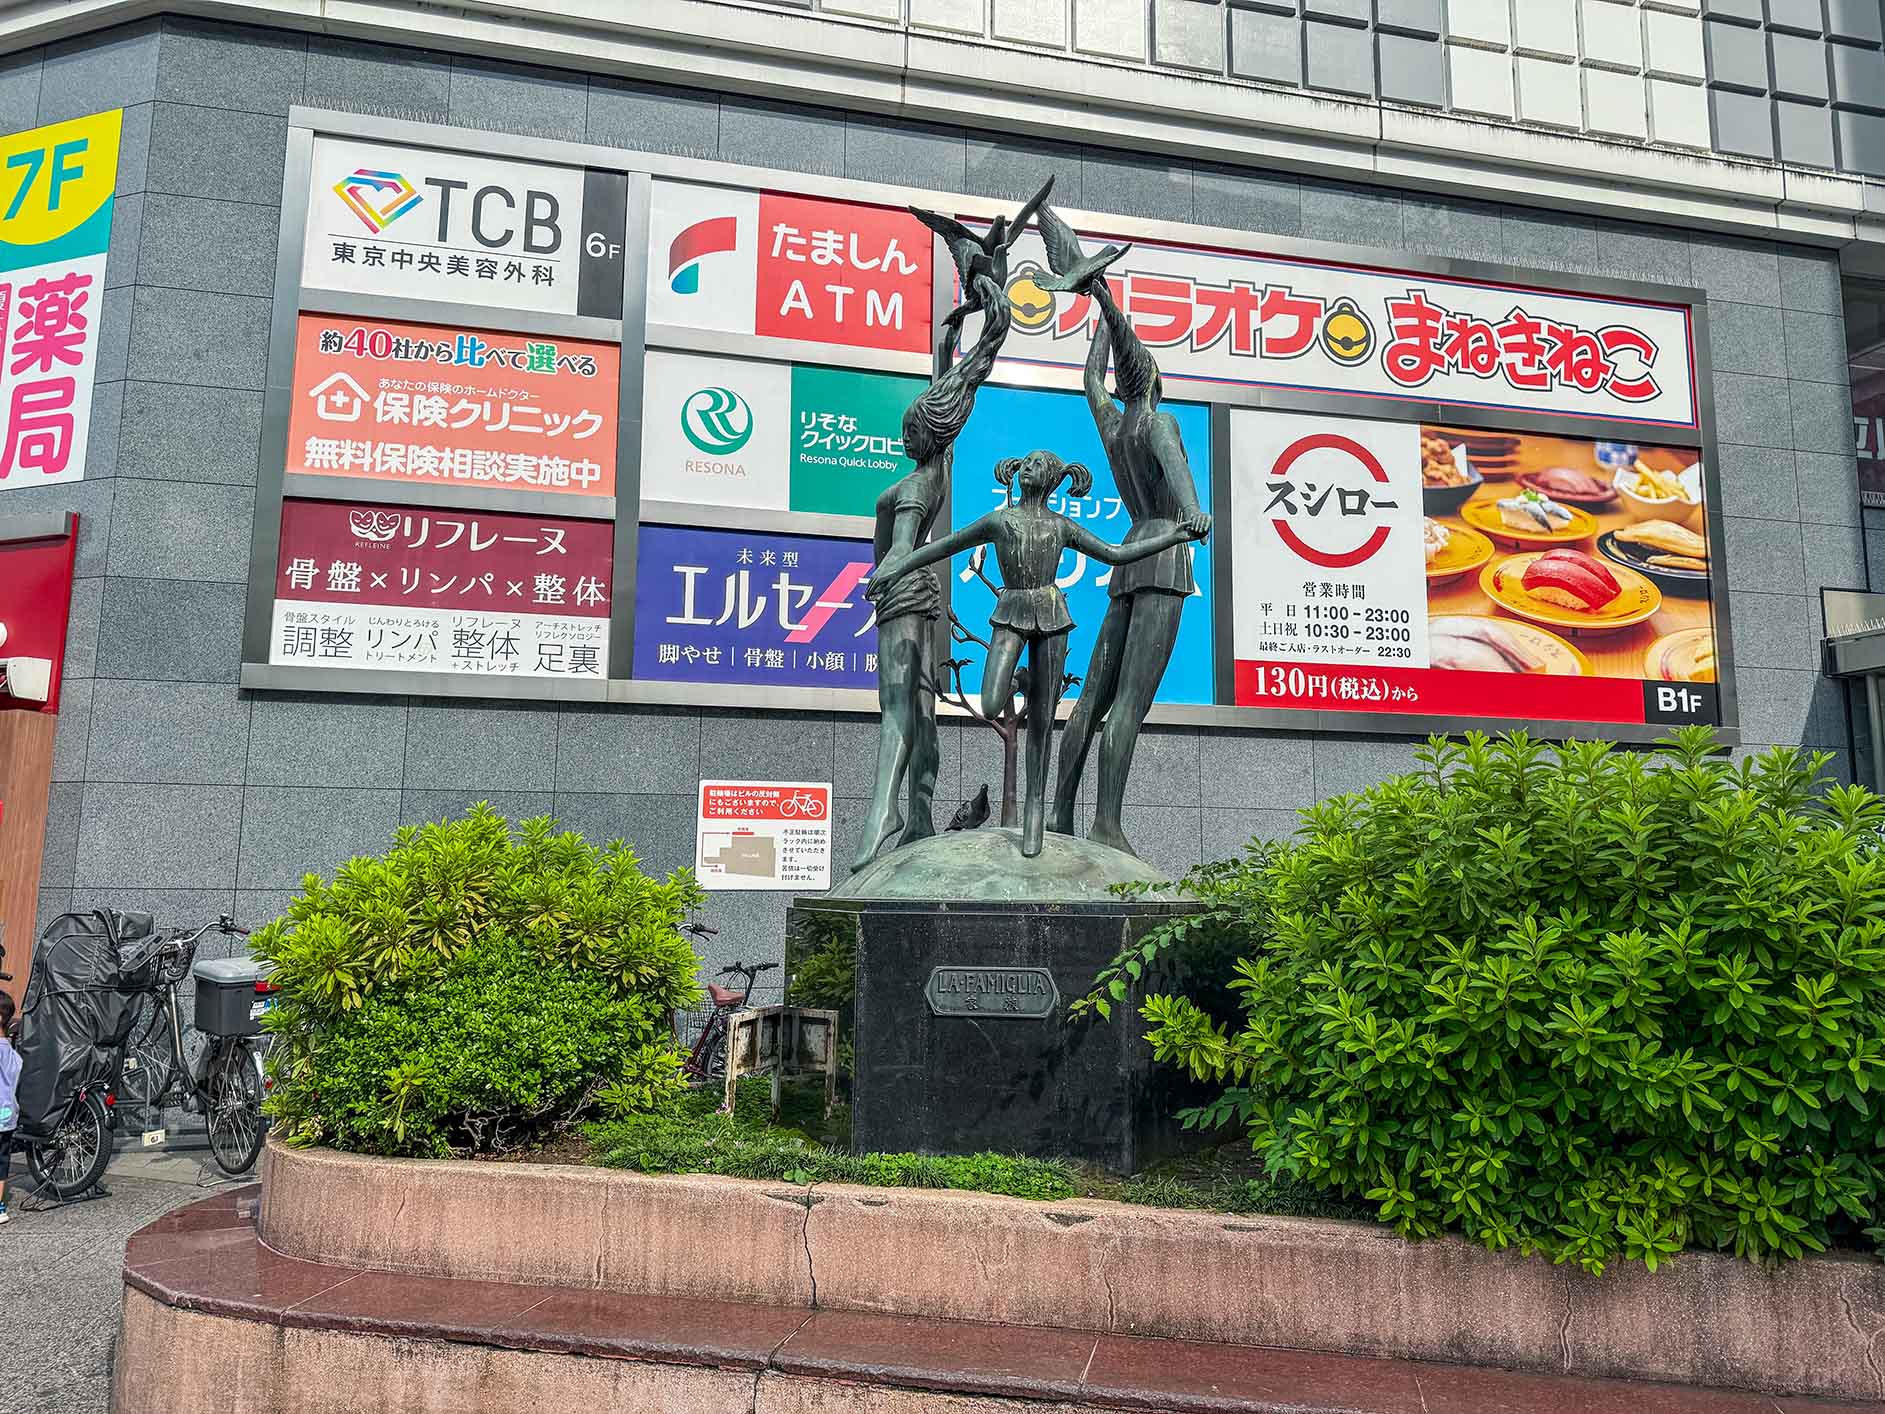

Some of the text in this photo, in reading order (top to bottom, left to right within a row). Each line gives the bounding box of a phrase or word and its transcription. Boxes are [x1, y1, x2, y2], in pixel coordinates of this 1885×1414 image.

[3, 137, 89, 220] 7F
[425, 176, 562, 254] TCB
[585, 231, 621, 260] 6F
[770, 222, 918, 276] たましん
[331, 241, 555, 286] 東京中央美容外科
[779, 279, 903, 330] ATM
[319, 328, 597, 377] 約40社から比べて選べる
[1381, 289, 1663, 403] まねきねこ
[378, 377, 541, 401] あなたの保険のホームドクター
[373, 391, 603, 439] 保険クリニック
[800, 410, 857, 432] りそな
[800, 430, 904, 456] クイックロビ
[304, 436, 601, 489] 無料保険相談実施中
[685, 459, 746, 477] RESONA
[800, 452, 898, 473] Resona Quick Lobby
[1263, 480, 1400, 517] スシロー
[403, 516, 568, 556] リフレーヌ
[736, 548, 799, 568] 未来型
[1302, 582, 1366, 600] 営業時間
[283, 611, 356, 626] 骨盤スタイル
[368, 616, 440, 629] じんわりとろける
[452, 616, 521, 630] リフレーヌ
[535, 621, 601, 632] アーチストレッチ
[1259, 621, 1298, 636] 土日祝
[282, 625, 353, 659] 調整
[366, 629, 438, 651] リンパ
[451, 628, 521, 661] 整体
[1377, 646, 1412, 659] 22:30
[364, 651, 437, 665] トリートメント
[533, 643, 601, 675] 足裏
[658, 644, 722, 666] 脚やせ
[744, 648, 785, 669] 骨盤
[806, 652, 845, 672] 小顔
[1657, 686, 1703, 713] B1F
